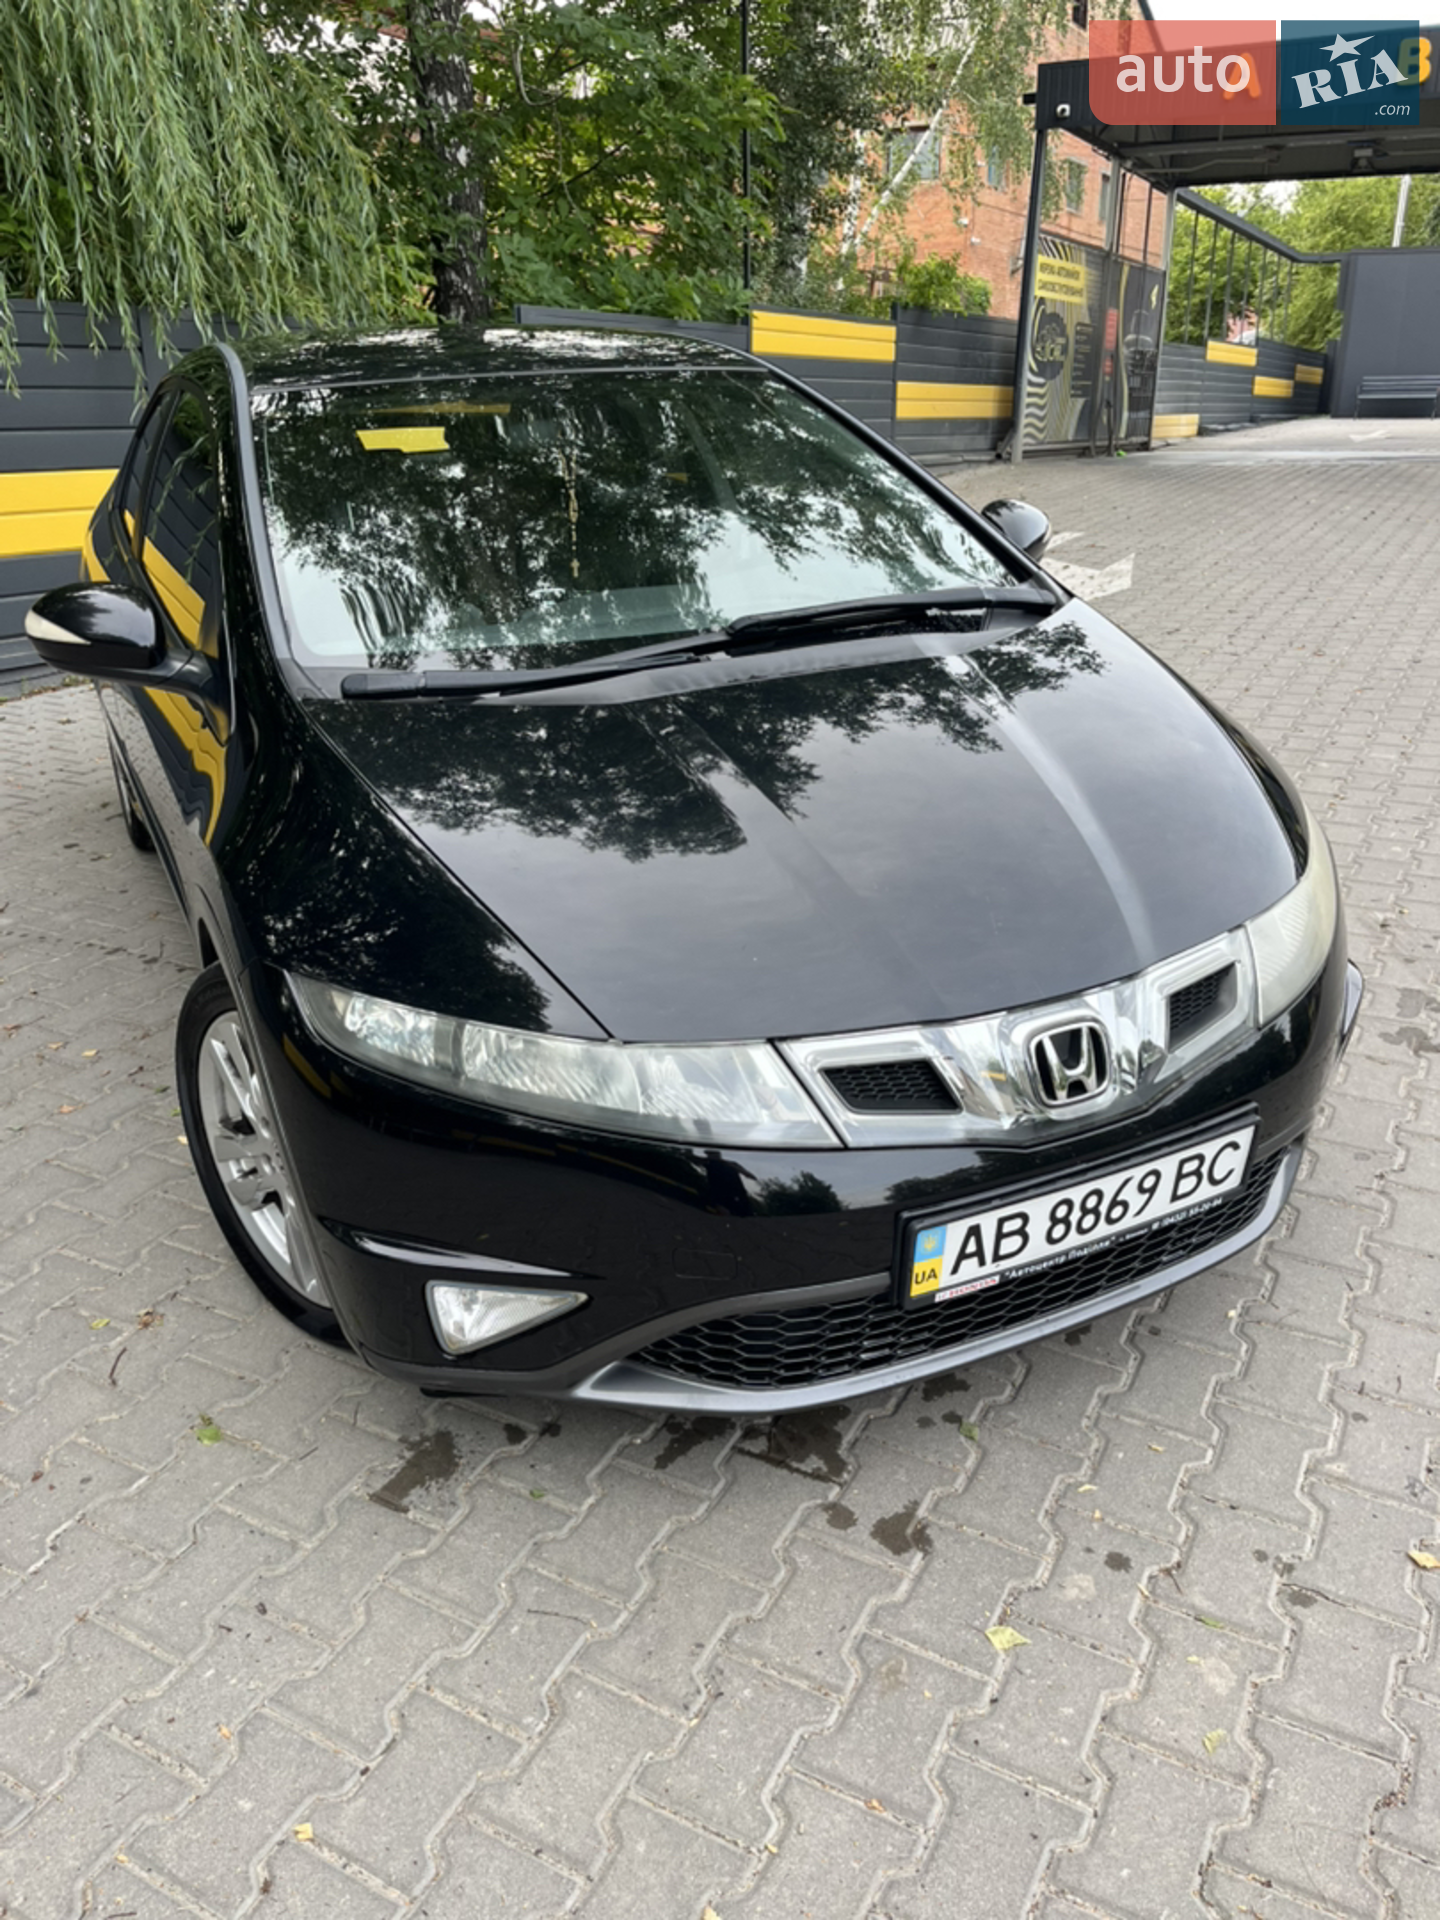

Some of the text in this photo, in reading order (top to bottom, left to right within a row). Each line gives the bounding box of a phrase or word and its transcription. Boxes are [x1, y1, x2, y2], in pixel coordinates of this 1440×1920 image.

[949, 1140, 1241, 1276] AB 8869 BC
[914, 1268, 938, 1285] UA
